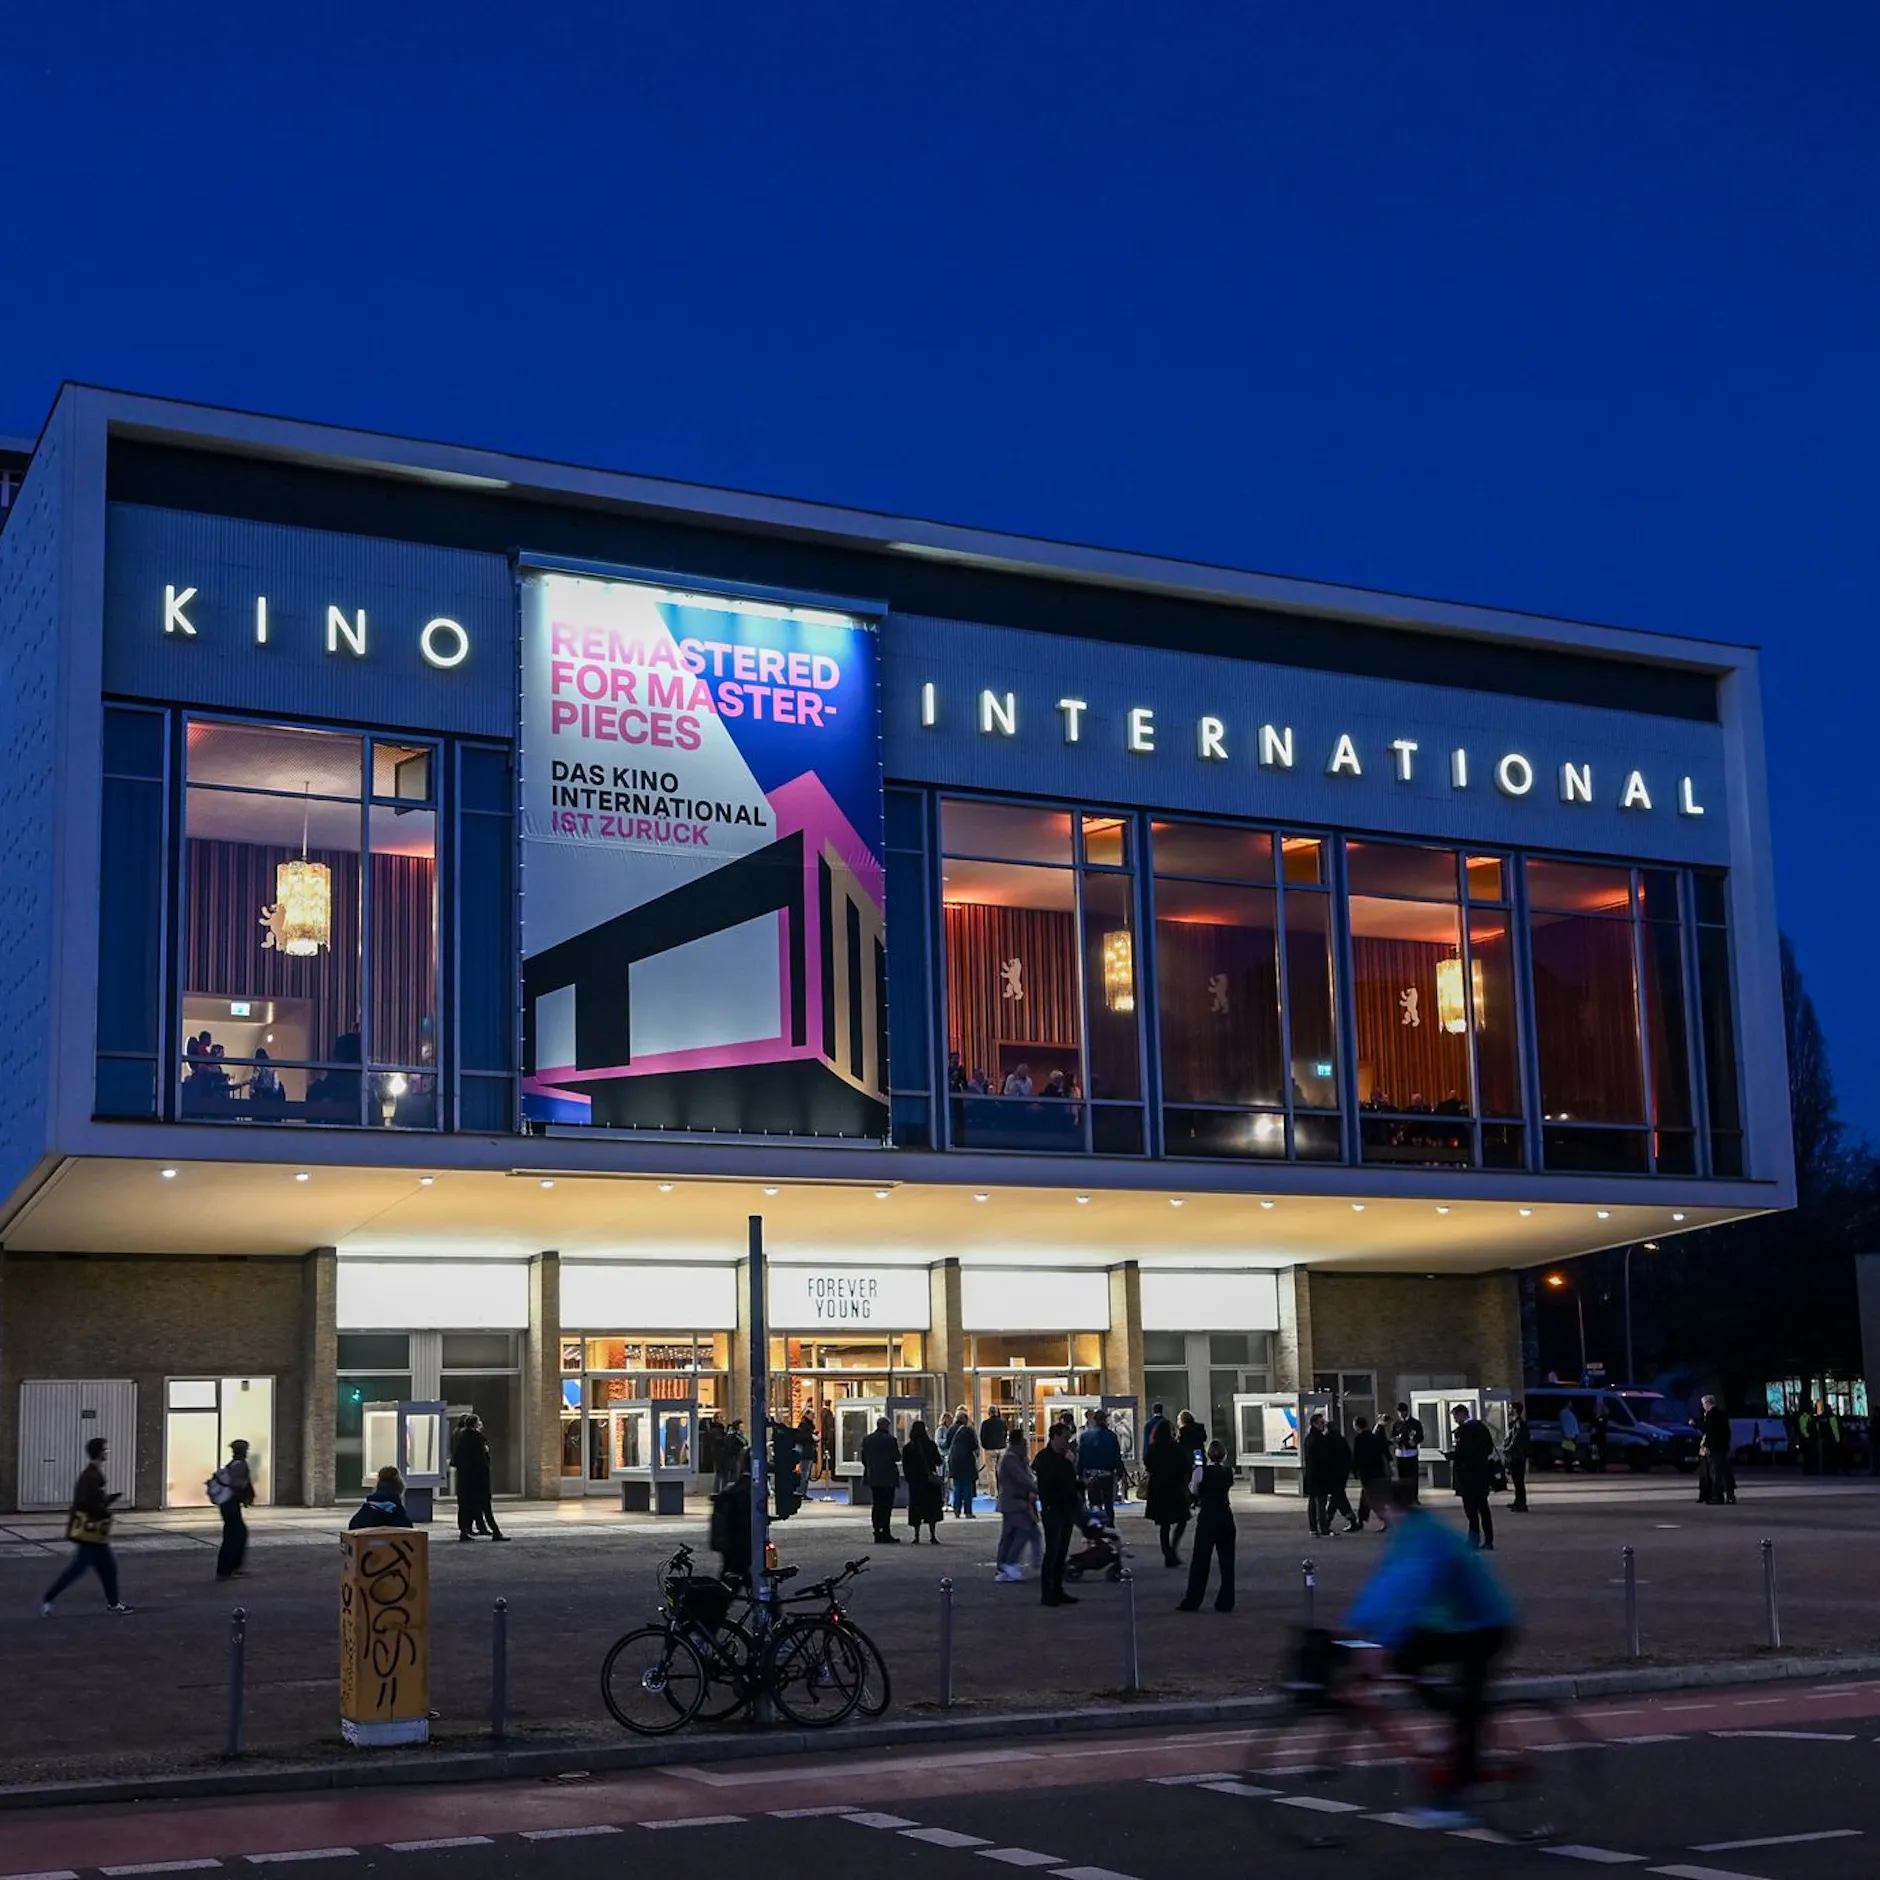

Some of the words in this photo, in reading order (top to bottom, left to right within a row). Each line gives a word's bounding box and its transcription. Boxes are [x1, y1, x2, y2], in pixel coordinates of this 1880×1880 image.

[552, 622, 840, 690] REMASTERED
[165, 584, 469, 668] KINO
[921, 682, 1704, 815] INTERNATIONAL
[552, 660, 637, 704] FOR
[648, 673, 838, 728] MASTER-
[552, 700, 702, 751] PIECES
[552, 760, 605, 785] DAS
[612, 767, 679, 793] KINO
[552, 785, 767, 827] INTERNATIONAL
[552, 811, 598, 836] IST
[602, 814, 709, 846] ZURÜCK
[808, 1278, 878, 1298] FOREVER
[815, 1299, 871, 1319] YOUNG
